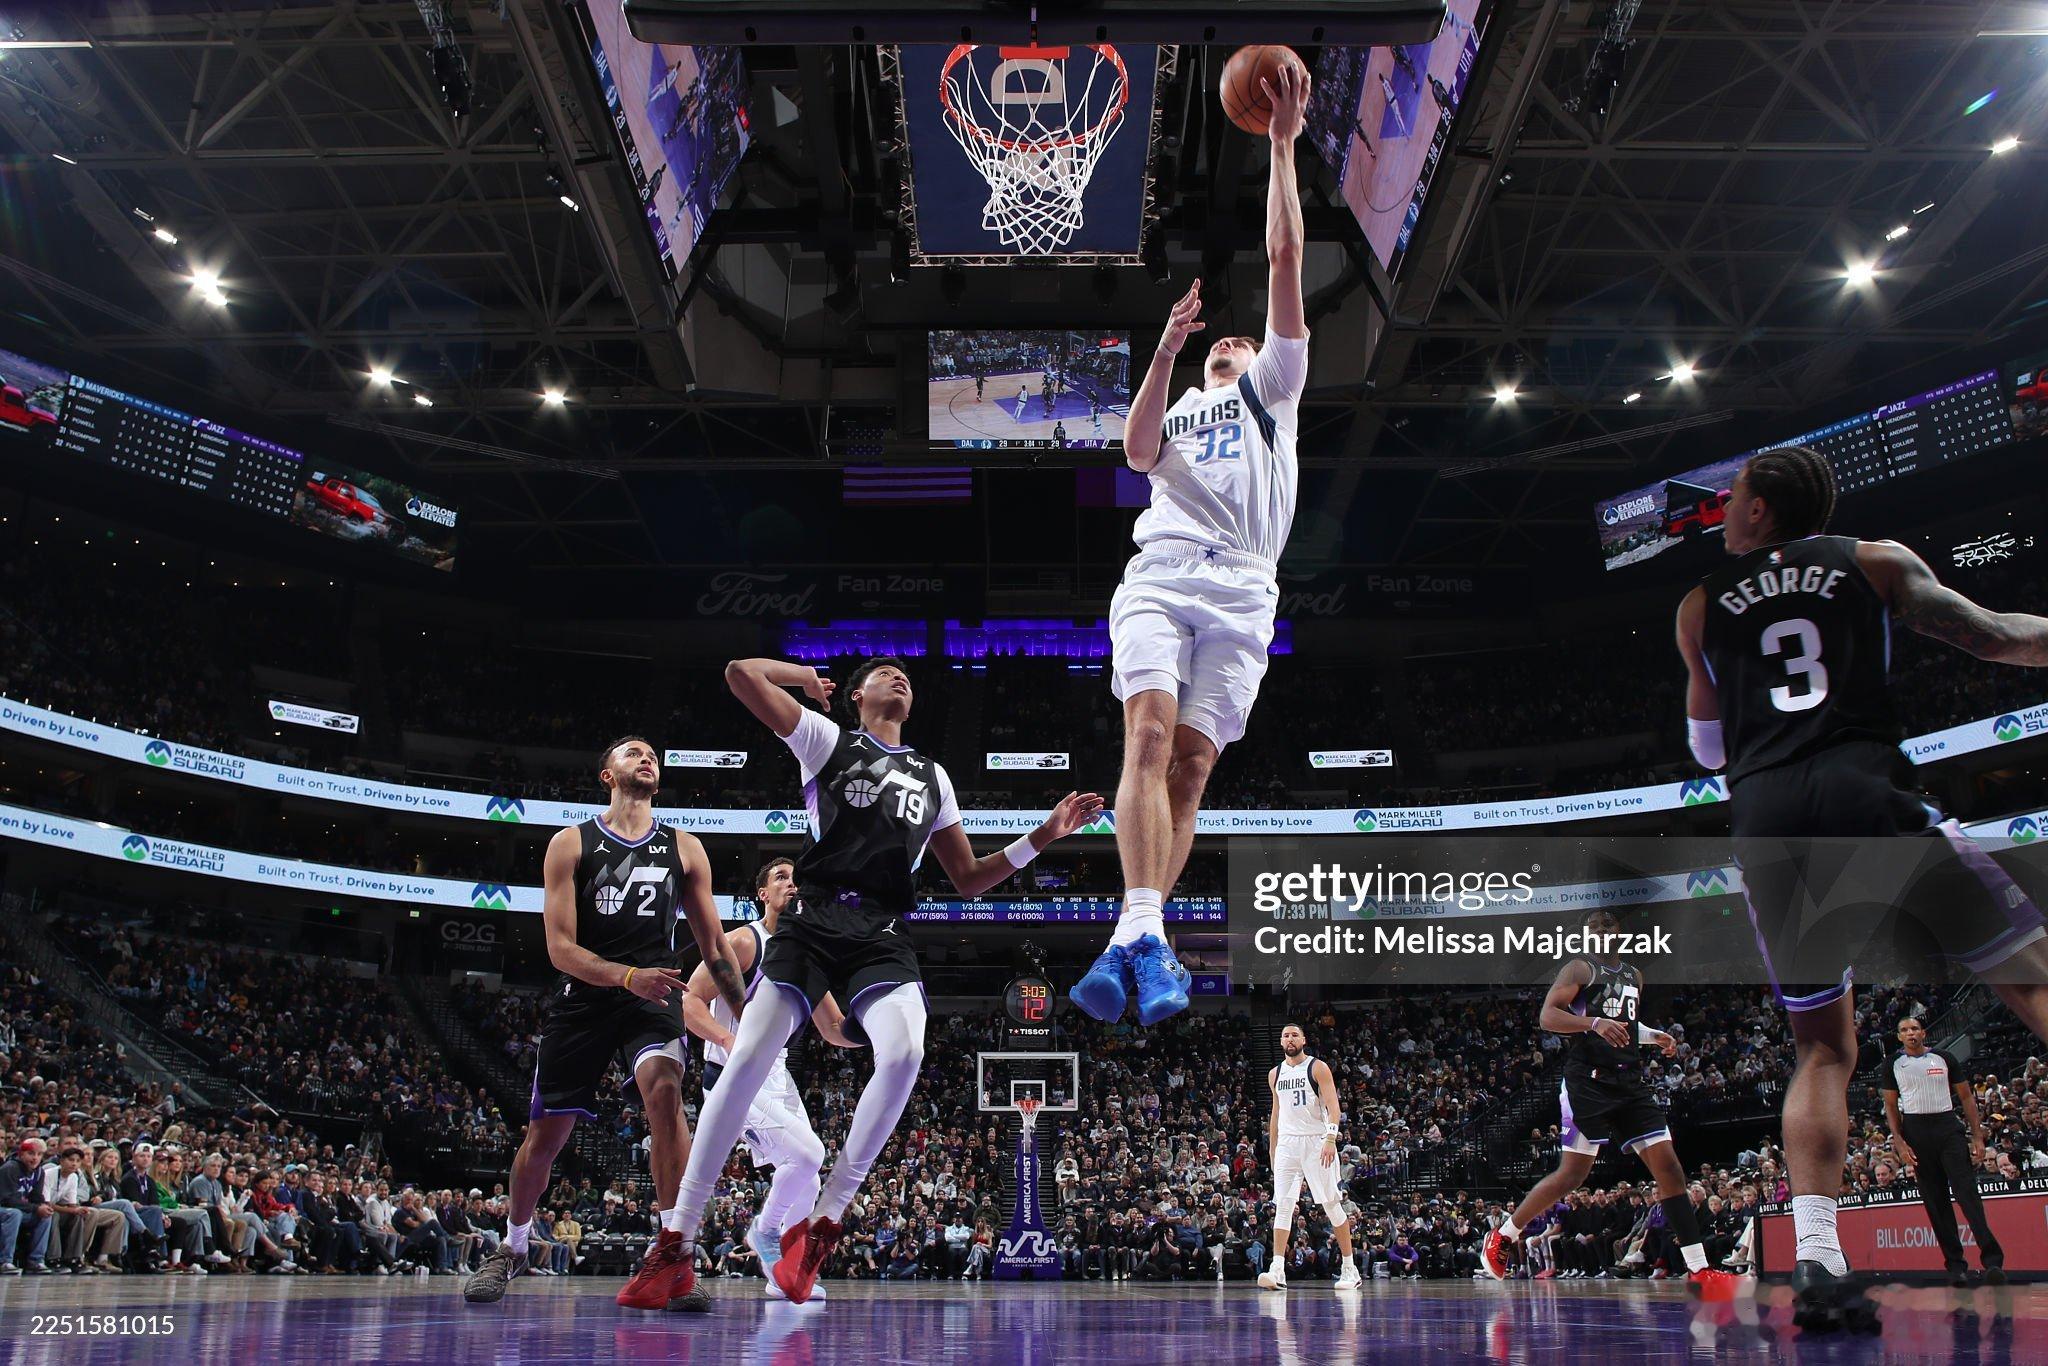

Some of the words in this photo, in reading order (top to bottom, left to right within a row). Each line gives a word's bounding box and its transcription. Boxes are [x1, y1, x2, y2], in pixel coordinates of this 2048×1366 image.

[85, 381, 126, 401] MAVERICKS
[1887, 401, 1907, 414] JAZZ
[206, 423, 226, 435] JAZZ
[1163, 400, 1240, 442] DALLAS
[961, 439, 974, 448] DAL
[999, 440, 1008, 448] 29
[1051, 440, 1060, 448] 29
[1084, 439, 1098, 448] UTA
[1195, 425, 1242, 463] 32
[422, 502, 457, 520] EXPLORE
[1617, 494, 1654, 512] EXPLORE
[420, 511, 455, 528] ELEVATED
[1619, 504, 1655, 521] ELEVATED
[1367, 575, 1410, 592] Fan
[1416, 575, 1473, 593] Zone
[1718, 565, 1848, 615] GEORGE
[696, 571, 817, 616] Ford
[838, 575, 880, 593] Fan
[886, 575, 944, 593] Zone
[1760, 618, 1829, 712] 3
[2, 706, 46, 729] Driven
[49, 720, 64, 735] by
[68, 726, 99, 742] Love
[1915, 741, 1945, 755] Love
[174, 747, 205, 761] MARK
[208, 754, 246, 770] MILLER
[172, 757, 245, 780] SUBARU
[277, 773, 305, 787] Built
[308, 780, 323, 789] on
[327, 782, 361, 797] Trust,
[364, 787, 402, 802] Driven
[405, 793, 420, 805] by
[422, 796, 450, 807] Love
[895, 789, 925, 825] 19
[1379, 811, 1406, 819] MARK
[1408, 809, 1442, 818] MILLER
[1473, 810, 1500, 820] Built
[1502, 810, 1517, 818] on
[1520, 806, 1553, 817] Trust,
[1556, 801, 1595, 814] Driven
[1597, 799, 1612, 811] by
[1614, 796, 1643, 807] Love
[562, 809, 588, 820] Built
[682, 815, 696, 827] by
[698, 816, 725, 826] Love
[962, 818, 998, 826] Driven
[1001, 818, 1014, 829] by
[1018, 818, 1044, 827] Love
[1198, 817, 1230, 828] Trust,
[1232, 817, 1268, 827] Driven
[1271, 817, 1284, 829] by
[1287, 817, 1312, 826] Love
[1379, 818, 1443, 828] SUBARU
[23, 819, 39, 834] by
[43, 825, 75, 840] Love
[152, 841, 184, 855] MARK
[186, 847, 226, 861] MILLER
[648, 845, 668, 854] LVT
[151, 849, 224, 873] SUBARU
[257, 864, 286, 877] Built
[289, 870, 305, 880] on
[308, 871, 343, 886] Trust,
[346, 877, 385, 890] Driven
[388, 882, 404, 894] by
[406, 884, 435, 895] Love
[637, 884, 657, 917] 2
[1560, 891, 1599, 903] Driven
[1601, 889, 1617, 902] by
[1620, 887, 1648, 898] Love
[910, 912, 928, 920] 10/17
[929, 912, 948, 920] (59%)
[961, 912, 973, 920] 3/5
[974, 912, 994, 920] (60%)
[1008, 912, 1020, 920] 6/6
[1021, 912, 1044, 920] (100%)
[1192, 912, 1203, 920] 141
[1209, 912, 1221, 920] 144
[931, 903, 948, 911] (71%)
[961, 903, 974, 911] 1/3
[975, 903, 993, 911] (33%)
[1009, 903, 1022, 911] 4/5
[1023, 903, 1043, 911] (80%)
[1191, 903, 1204, 911] 144
[1210, 903, 1220, 911] 141
[1308, 904, 1328, 919] PM
[1380, 906, 1445, 916] SUBARU
[440, 920, 496, 943] G2G
[1021, 985, 1046, 998] 3:03
[1024, 999, 1044, 1020] 12
[1627, 998, 1636, 1021] 8
[1277, 1077, 1306, 1091] DALLAS
[1293, 1090, 1307, 1107] 31
[1023, 1155, 1032, 1181] FIRST
[1873, 1192, 1894, 1201] DELTA
[1983, 1182, 2009, 1193] DELTA
[1023, 1182, 1032, 1225] AMERICA
[1762, 1203, 1779, 1212] DELTA
[1842, 1195, 1861, 1204] DELTA
